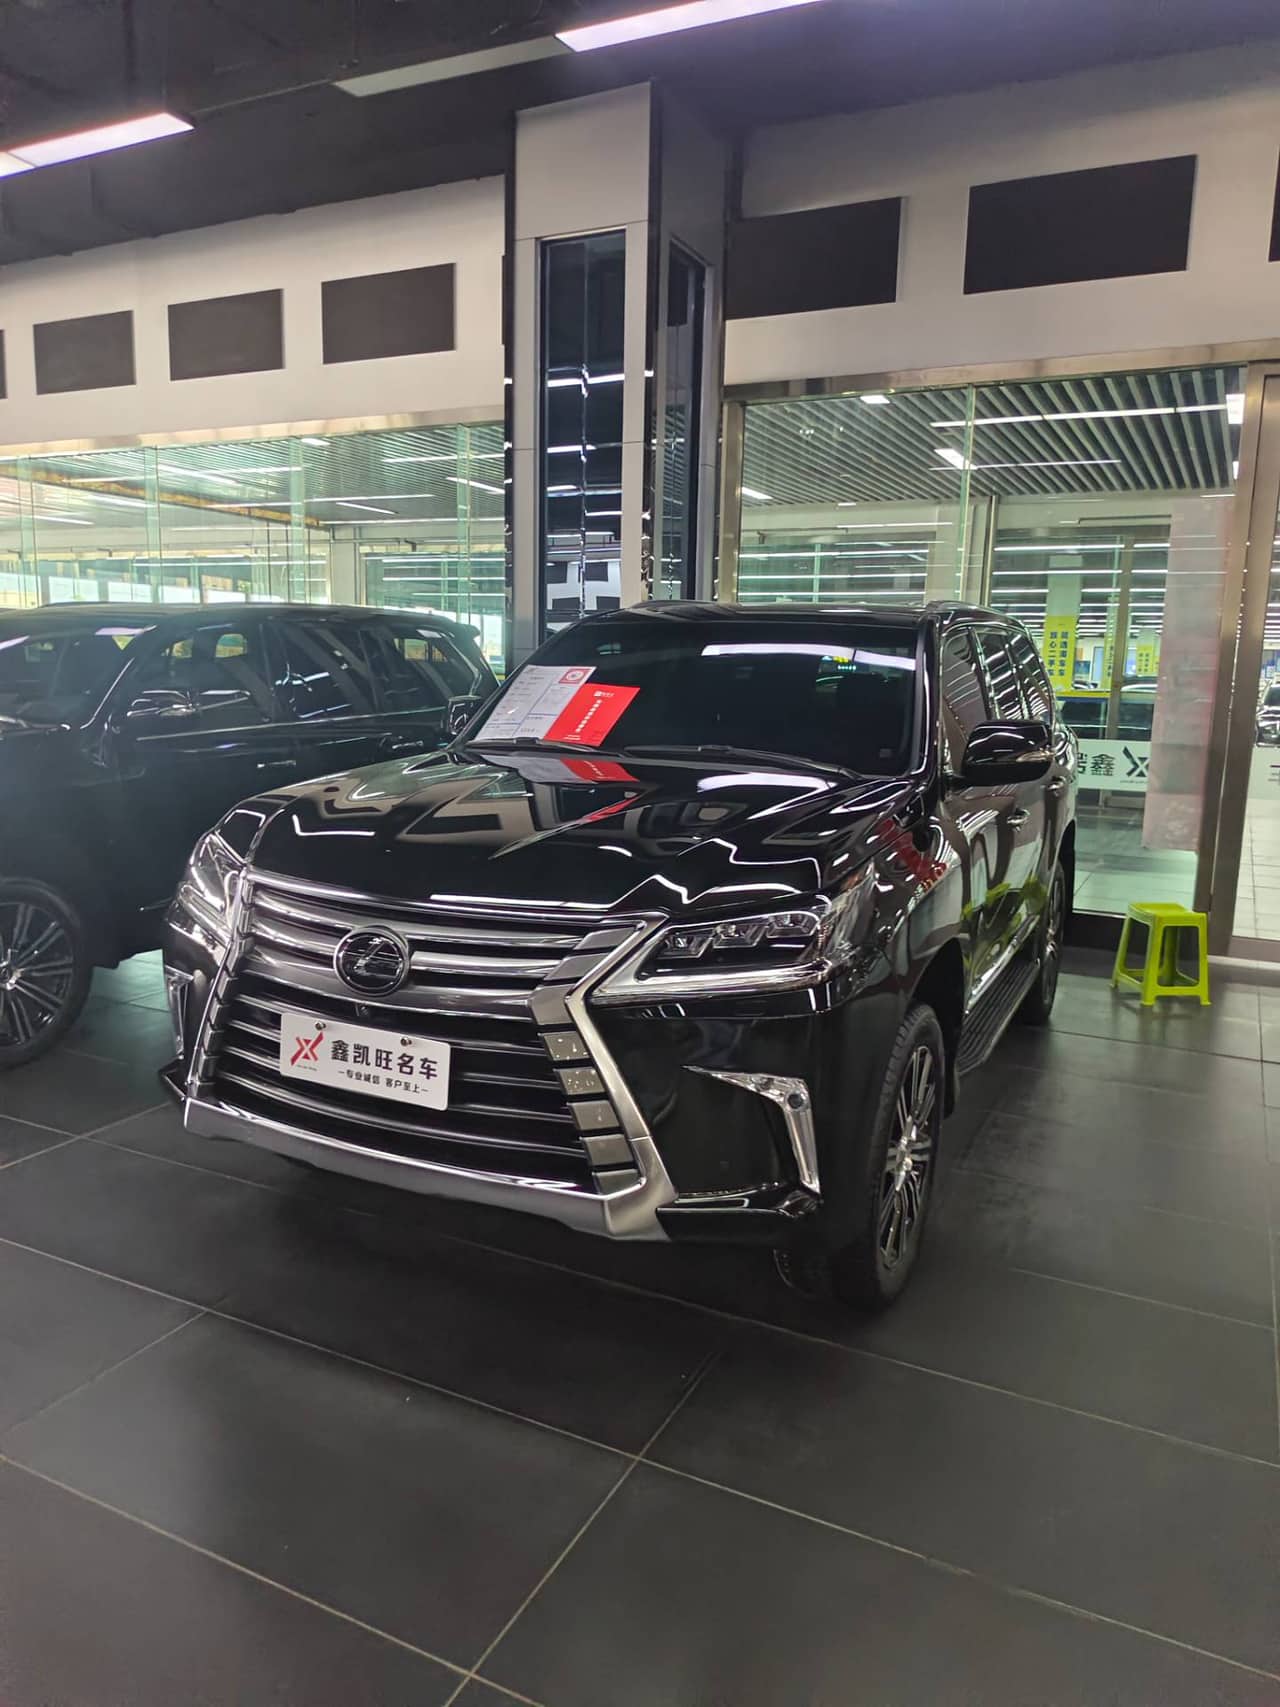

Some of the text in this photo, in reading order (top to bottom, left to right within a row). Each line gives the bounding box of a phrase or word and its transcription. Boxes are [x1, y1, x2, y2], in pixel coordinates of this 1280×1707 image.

[330, 1039, 438, 1081] 鑫凯旺名车
